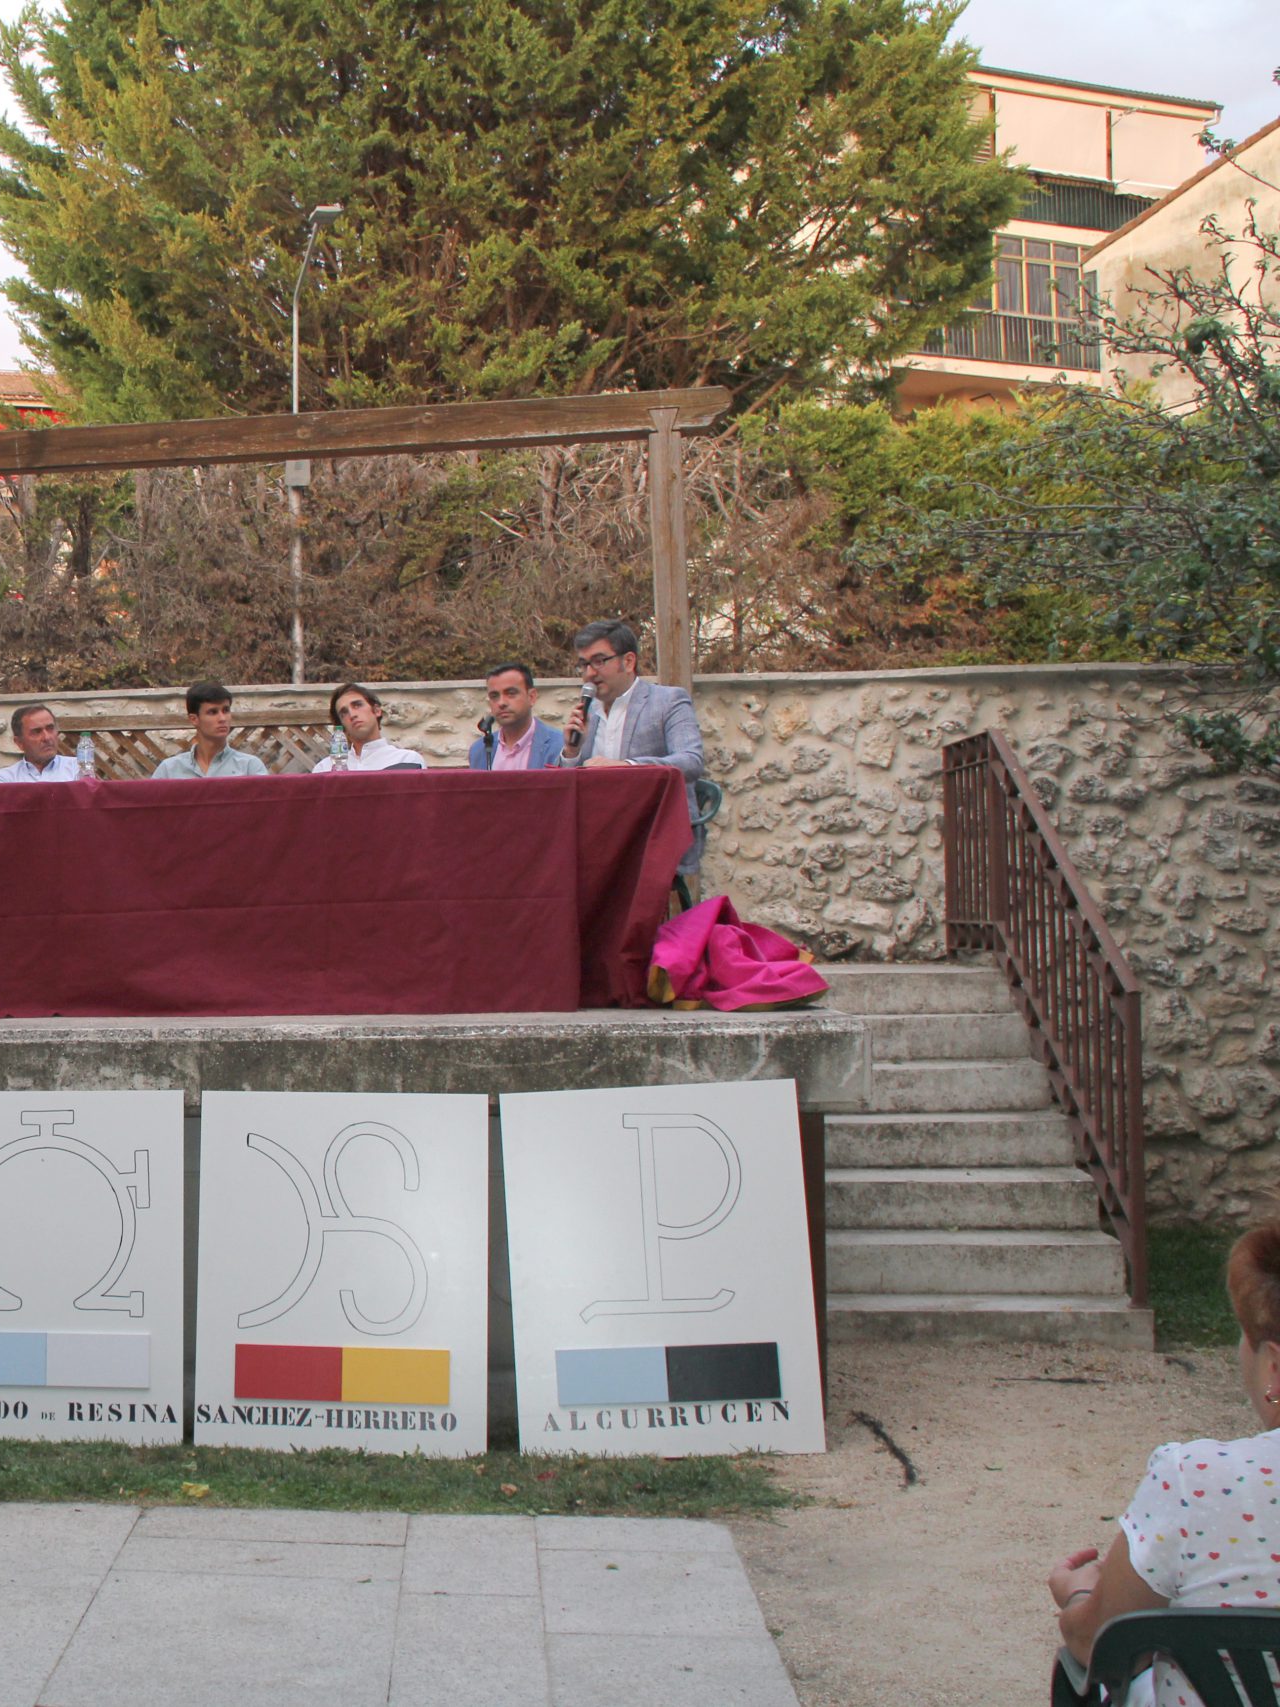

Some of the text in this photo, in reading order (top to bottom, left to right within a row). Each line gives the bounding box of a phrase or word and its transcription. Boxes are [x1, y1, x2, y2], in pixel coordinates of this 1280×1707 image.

[40, 1410, 56, 1421] DE
[67, 1402, 178, 1424] RESINA
[543, 1400, 791, 1432] ALCURRUCEN
